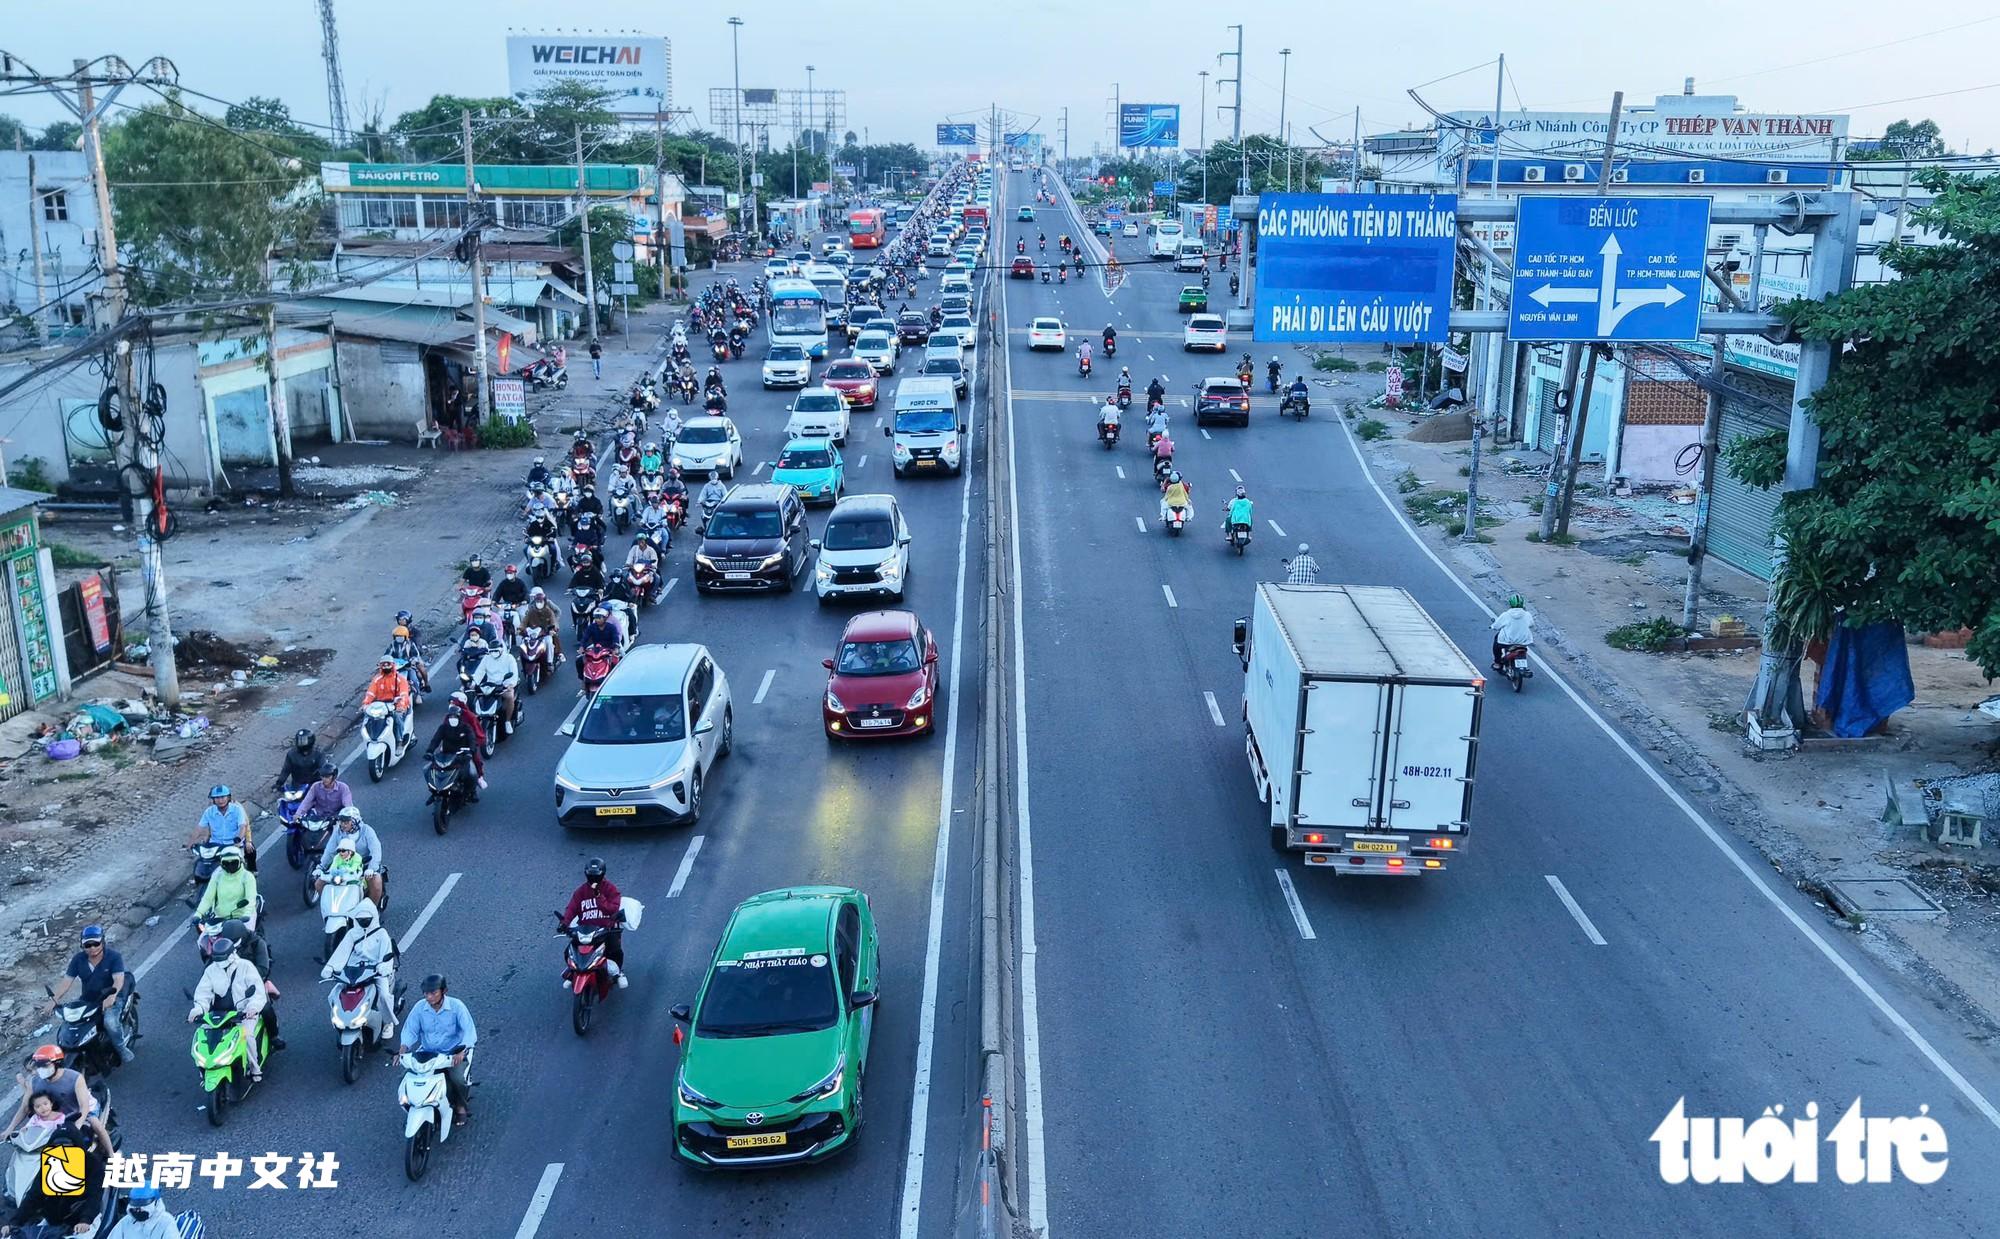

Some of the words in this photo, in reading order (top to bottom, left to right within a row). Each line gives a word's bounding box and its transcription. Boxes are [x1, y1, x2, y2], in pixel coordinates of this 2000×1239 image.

[532, 45, 641, 64] WEICHAI
[1536, 119, 1577, 132] Nhánh
[1582, 120, 1609, 133] Côn
[1620, 121, 1637, 136] Ty
[1640, 121, 1659, 133] CP
[1665, 114, 1719, 135] THÉP
[1721, 118, 1762, 140] VẠN
[1765, 115, 1835, 136] THÀNH
[402, 172, 439, 181] PETRO
[1258, 201, 1287, 236] CÁC
[1291, 204, 1348, 237] PHƯƠNG
[1352, 203, 1385, 244] TIỆN
[1387, 210, 1401, 237] ĐI
[1406, 195, 1455, 237] THẲNG
[1589, 200, 1612, 227] BẾN
[1528, 254, 1542, 263] CAO
[1543, 251, 1557, 263] TỐC
[1570, 255, 1584, 264] HCM
[1648, 255, 1662, 264] CAO
[1664, 251, 1677, 264] TỐC
[1516, 269, 1533, 278] LONG
[1272, 295, 1306, 332] PHẢI
[1310, 305, 1324, 332] ĐI
[1328, 299, 1356, 332] LÊN
[1360, 296, 1389, 332] CẦU
[1393, 300, 1433, 340] VƯỢT
[1562, 313, 1578, 322] LINH
[496, 383, 522, 392] HONDA
[1403, 766, 1451, 777] 48H-022.11
[788, 957, 807, 966] GIÁO
